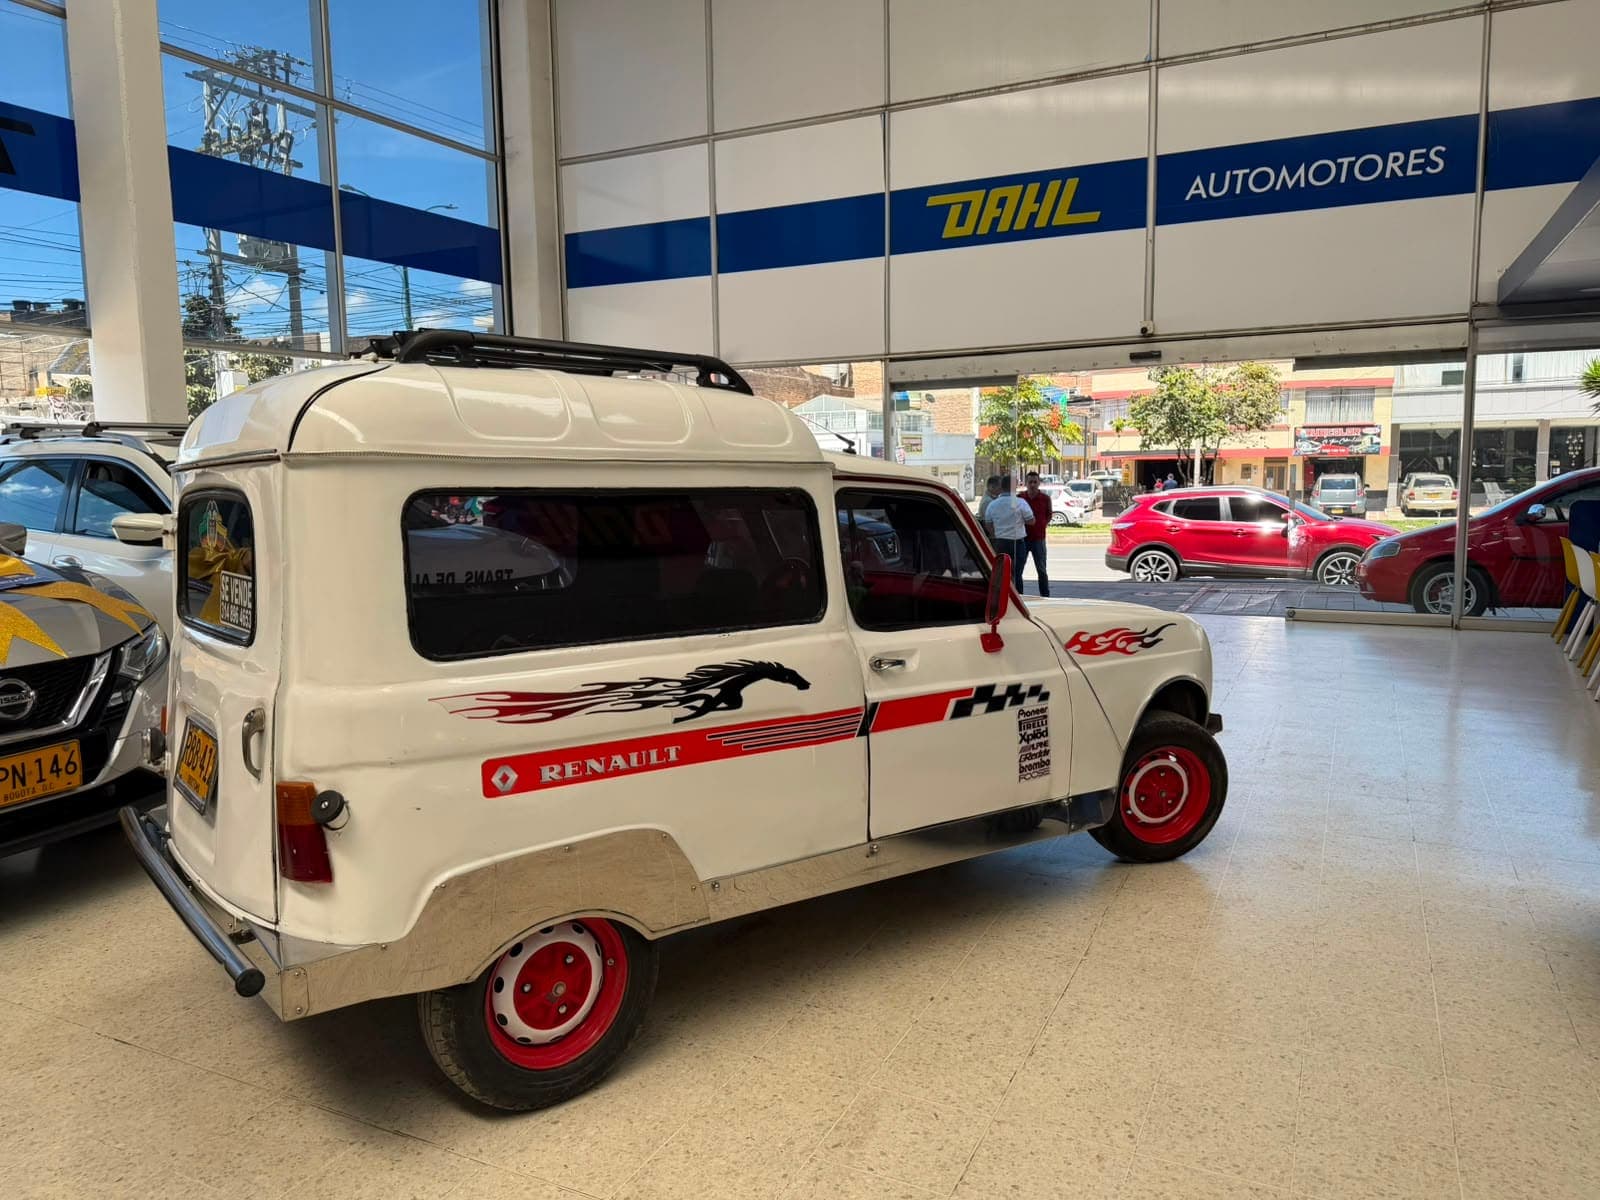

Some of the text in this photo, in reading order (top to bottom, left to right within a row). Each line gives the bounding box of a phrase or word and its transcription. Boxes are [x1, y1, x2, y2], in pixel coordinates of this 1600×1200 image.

[926, 145, 1447, 239] DAHL AUTOMOTORES
[221, 574, 252, 609] SE VENDE
[1018, 708, 1048, 719] Pioneer
[1018, 714, 1048, 732] PIRELLI
[34, 749, 77, 784] 146
[539, 746, 680, 783] RENAULT
[1019, 758, 1051, 774] brembo
